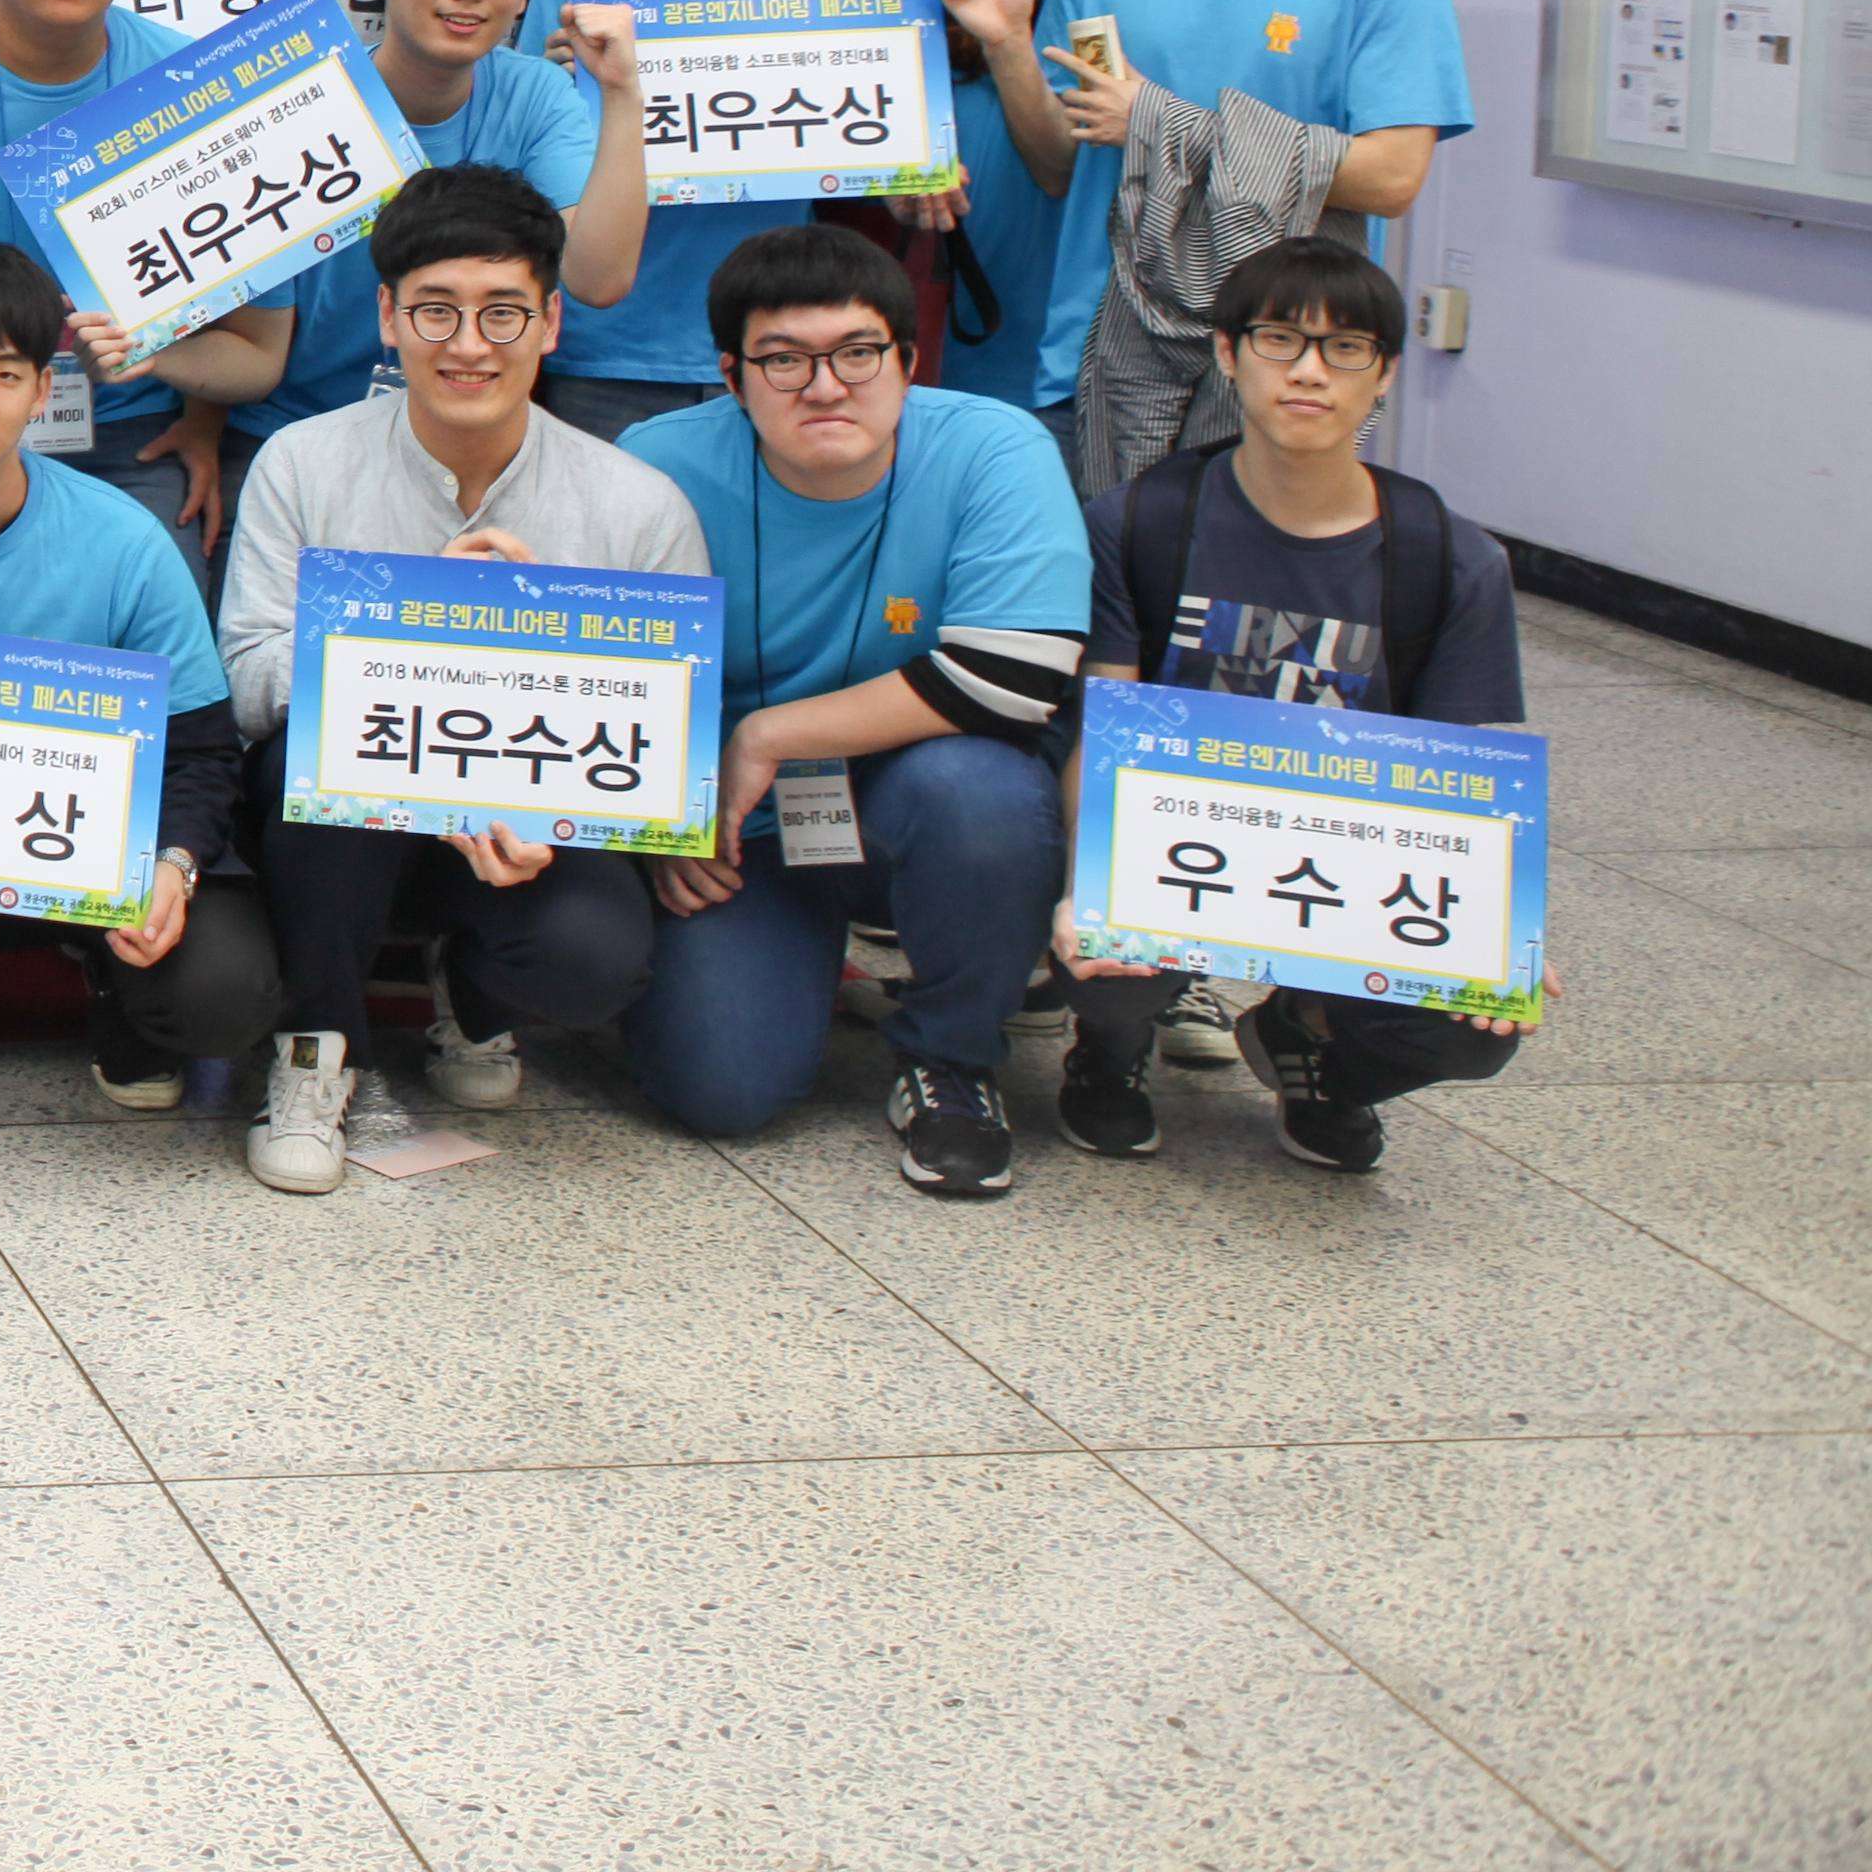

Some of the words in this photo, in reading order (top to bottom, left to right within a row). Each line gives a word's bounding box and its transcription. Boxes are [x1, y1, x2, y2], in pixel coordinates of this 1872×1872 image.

[636, 59, 673, 74] 2018
[679, 55, 739, 72] 창의융합
[745, 51, 822, 70] 소프트웨어
[828, 47, 889, 65] 경진대회
[644, 84, 894, 154] 최우수상
[87, 191, 127, 224] 제2회
[196, 116, 267, 167] 소프트웨어
[266, 83, 325, 125] 경진대회
[223, 145, 260, 182] 활용)
[127, 132, 362, 299] 최우수상
[53, 409, 84, 422] MODI
[362, 661, 406, 680] 2018
[578, 677, 648, 700] 경진대회
[31, 747, 98, 773] 경진대회
[356, 702, 651, 793] 최우수상
[1152, 795, 1200, 817] 2018
[1207, 801, 1282, 829] 창의융합
[1289, 812, 1384, 843] 소프트웨어
[1394, 827, 1470, 857] 경진대회
